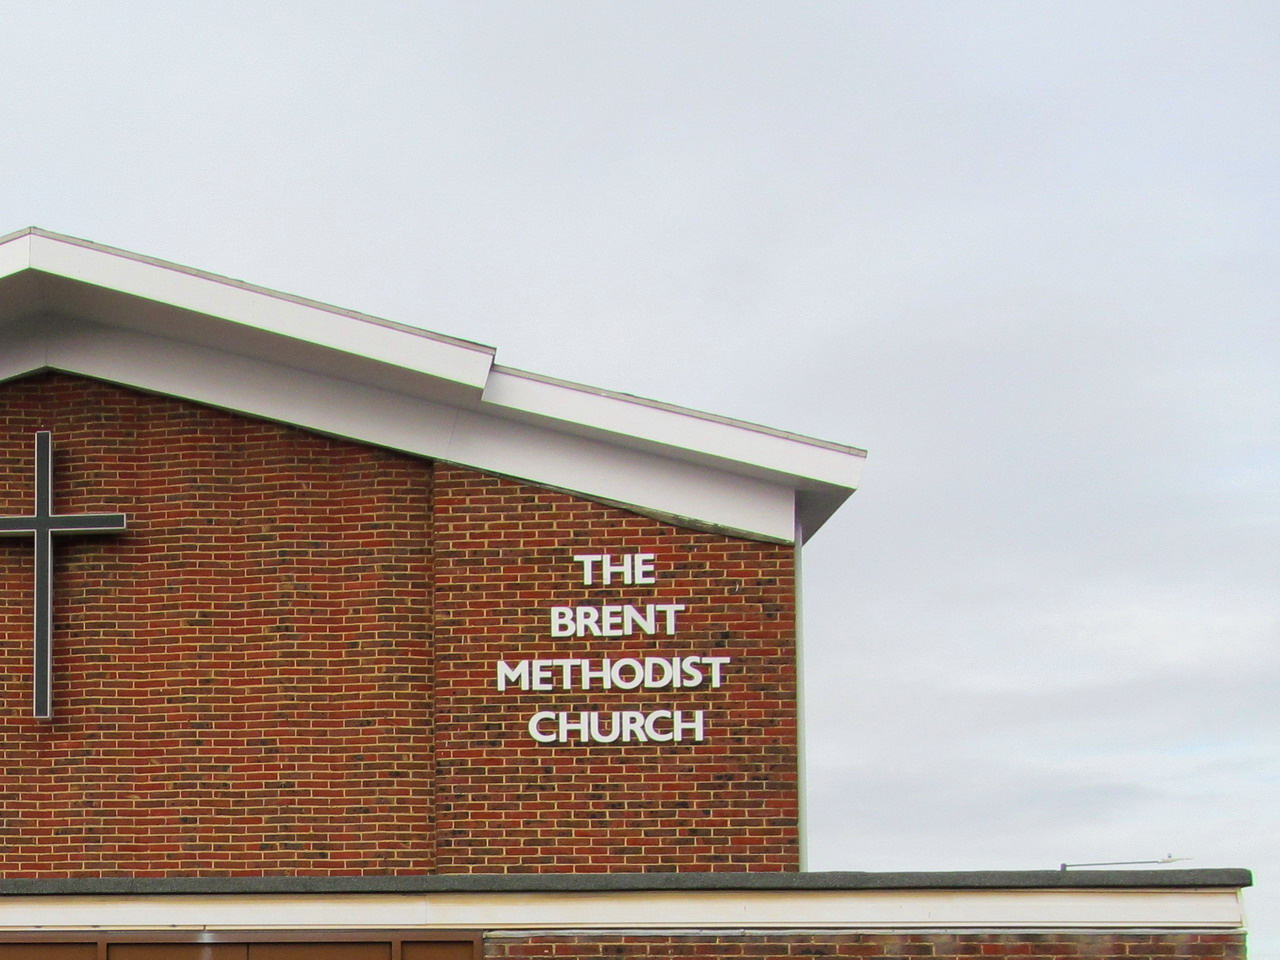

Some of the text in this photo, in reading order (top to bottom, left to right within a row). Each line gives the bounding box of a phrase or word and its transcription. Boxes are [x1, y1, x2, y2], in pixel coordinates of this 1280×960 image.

[574, 554, 655, 585] THE
[551, 604, 685, 637] BRENT
[497, 656, 730, 691] METHODIST
[528, 710, 704, 742] CHURCH
